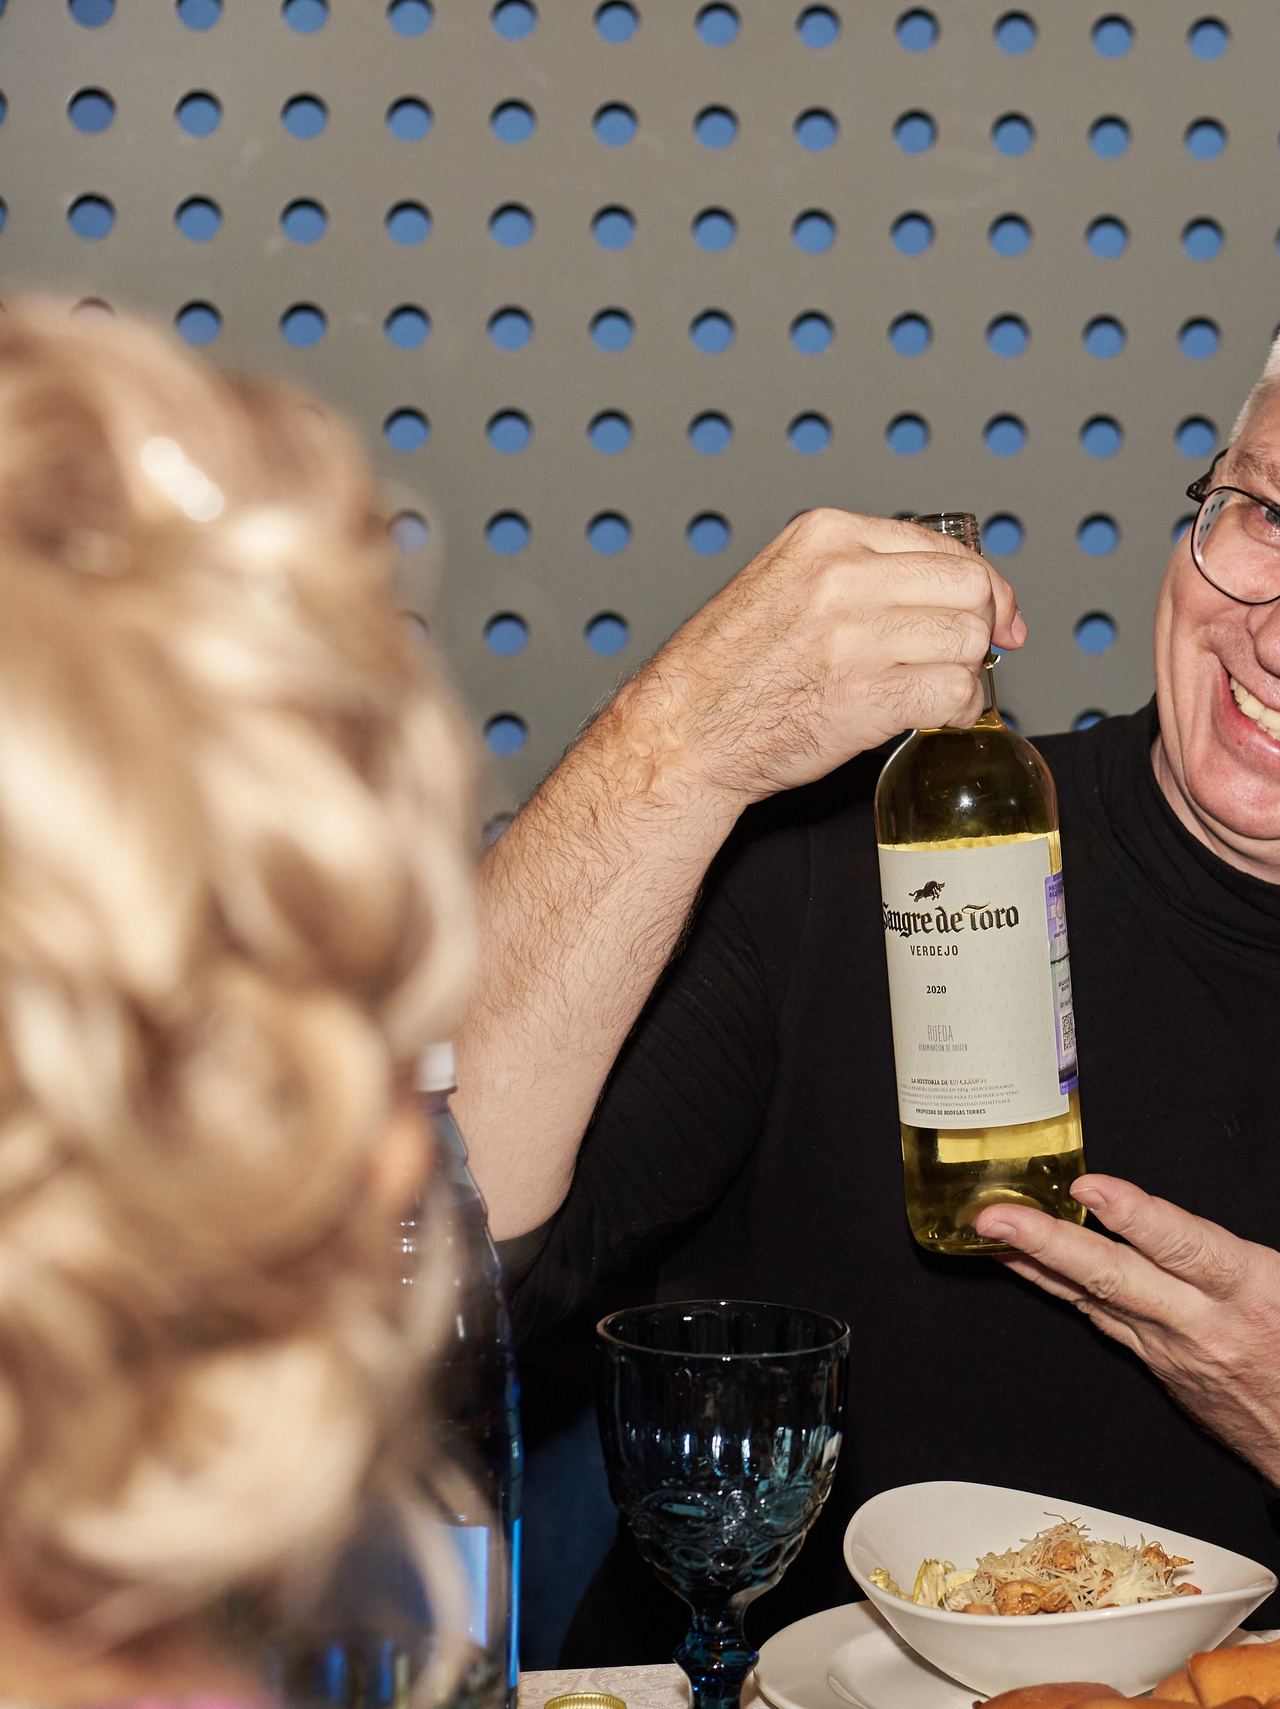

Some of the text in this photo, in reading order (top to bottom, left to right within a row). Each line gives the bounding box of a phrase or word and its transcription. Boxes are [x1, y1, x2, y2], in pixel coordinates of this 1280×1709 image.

[883, 902, 1019, 938] Sangre de Toro
[910, 945, 959, 956] VERDEJO
[926, 985, 947, 994] 2020
[927, 1024, 954, 1042] RUEDA
[971, 1083, 1014, 1091] SELECCIONAMOS
